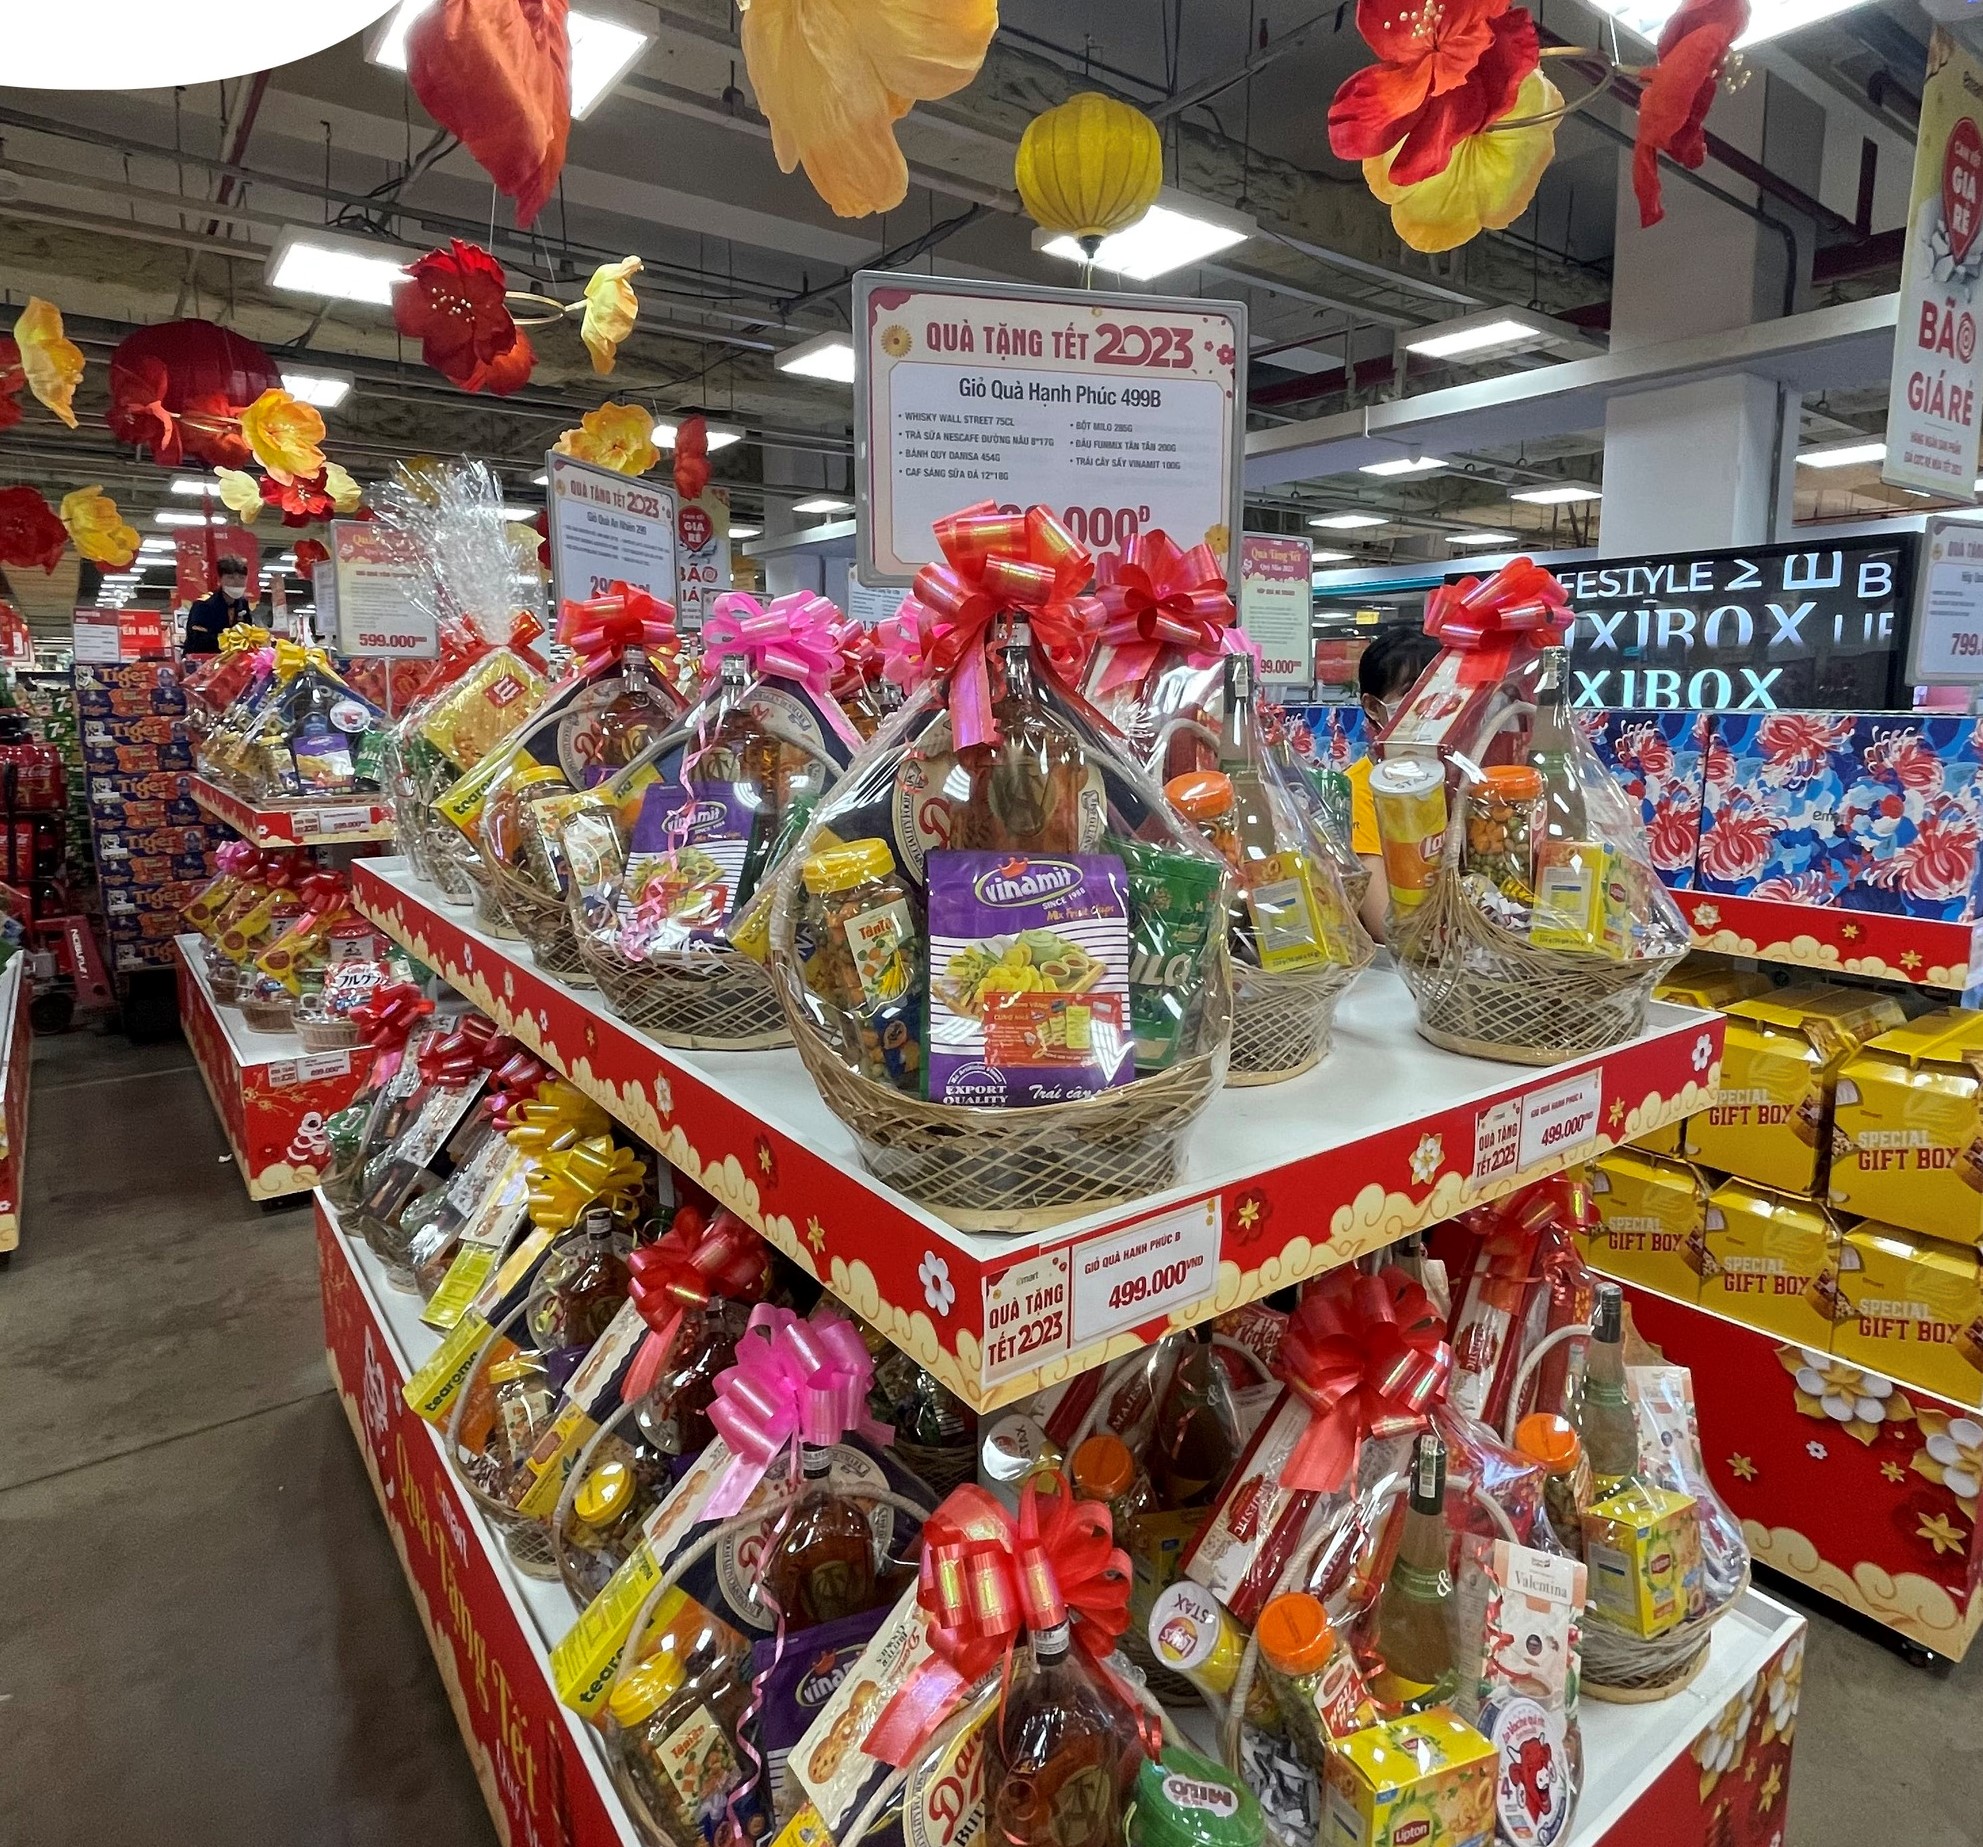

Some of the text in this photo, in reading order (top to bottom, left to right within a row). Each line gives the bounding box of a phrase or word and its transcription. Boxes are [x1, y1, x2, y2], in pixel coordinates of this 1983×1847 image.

[926, 320, 1194, 369] QUÀ TẶNG TẾT 2023
[959, 377, 1161, 408] Giỏ Quà Hạnh Phúc 499B
[905, 412, 1015, 426] WHISKY WALL STREET 75CL
[943, 432, 979, 443] NESCAFE
[930, 450, 946, 459] QUY
[949, 451, 979, 460] DANISA
[1128, 460, 1160, 468] VINAMIT
[627, 491, 659, 519] 2023
[1260, 659, 1294, 673] 99.000
[101, 666, 150, 689] Tiger
[112, 722, 163, 743] Tiger
[118, 777, 169, 800] Tiger
[126, 835, 177, 856] Tiger
[985, 866, 1072, 904] vinamit
[133, 890, 183, 912] Tiger
[1042, 896, 1067, 910] SINCE
[1129, 953, 1192, 986] ILO
[943, 1095, 1008, 1105] QUALITY
[945, 1085, 1007, 1095] EXPORT
[1029, 1084, 1061, 1100] Trái
[1710, 1105, 1750, 1126] GIFT
[1478, 1123, 1518, 1152] QUÀ TẶNG
[1858, 1130, 1931, 1149] SPECIAL
[1476, 1143, 1516, 1178] TẾT 2023
[1858, 1148, 1909, 1171] GIFT
[1609, 1215, 1661, 1233] SPECIAL
[1608, 1232, 1647, 1251] GIFT
[1084, 1231, 1181, 1275] GIỎ QUÀ HẠNH PHÚC B
[1724, 1257, 1786, 1274] SPECIAL
[1724, 1273, 1768, 1294] GIFT
[988, 1283, 1064, 1329] QUÀ TẶNG
[1858, 1299, 1932, 1320] SPECIAL
[988, 1311, 1063, 1366] TẾT 2023
[1858, 1318, 1909, 1340] GIFT
[1514, 1570, 1568, 1598] Valentina
[1174, 1593, 1209, 1624] STAX
[1395, 1824, 1428, 1844] Lipton
